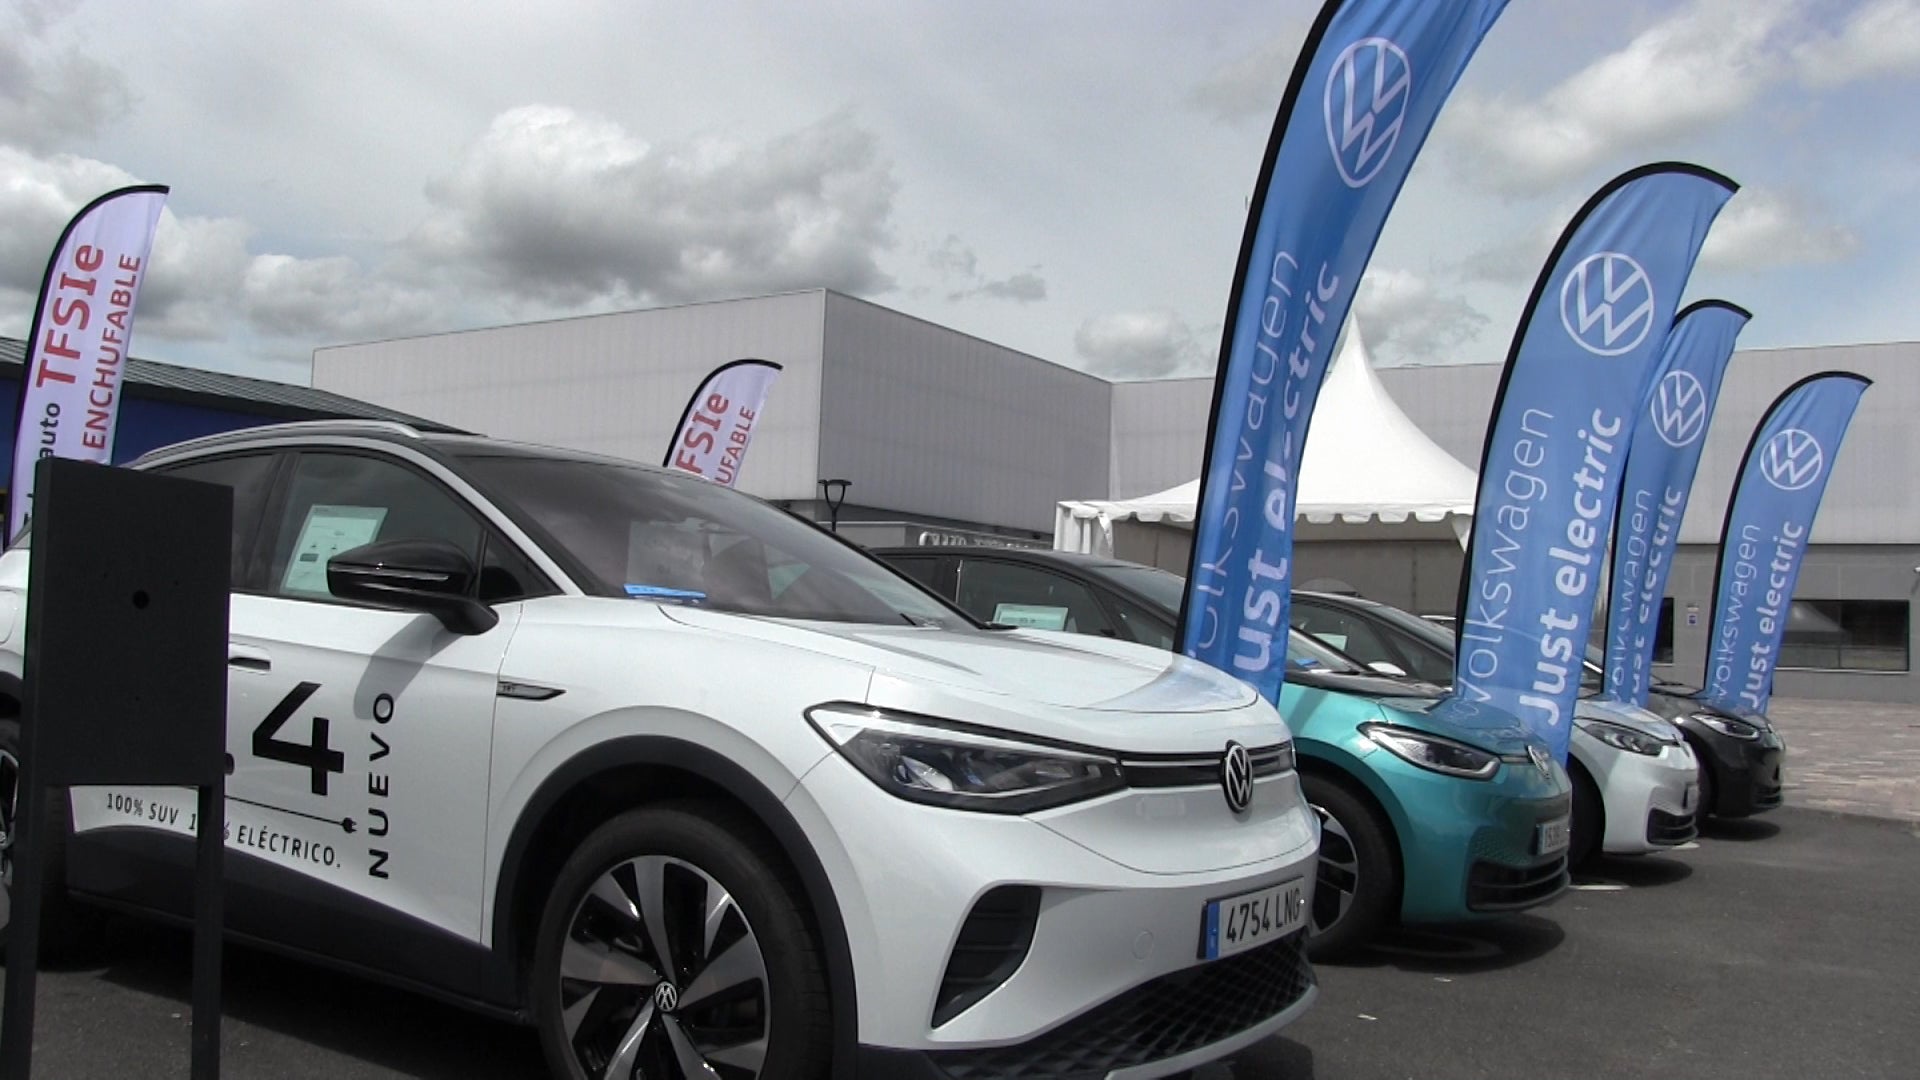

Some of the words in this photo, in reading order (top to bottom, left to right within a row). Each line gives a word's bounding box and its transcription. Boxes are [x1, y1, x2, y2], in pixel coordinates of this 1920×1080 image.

[1323, 36, 1411, 189] VW
[35, 243, 105, 389] TFSIe
[82, 253, 141, 450] ENCHUFABLE
[1560, 252, 1654, 356] VW
[674, 392, 730, 474] FSIe
[714, 405, 756, 485] UFABLE
[1651, 369, 1706, 447] VW
[1760, 428, 1822, 490] VW
[1457, 408, 1554, 703] Volkswagen
[1548, 407, 1621, 597] electric
[1232, 548, 1288, 672] ust
[1519, 607, 1579, 727] Just
[1740, 641, 1770, 710] Just
[1756, 520, 1803, 635] electric
[106, 792, 143, 817] 100%
[148, 802, 179, 825] SUV
[236, 825, 342, 868] ELÉCTRICO.
[367, 692, 395, 880] NUEVO
[1226, 898, 1271, 943] 4754
[1275, 887, 1301, 930] LNG
